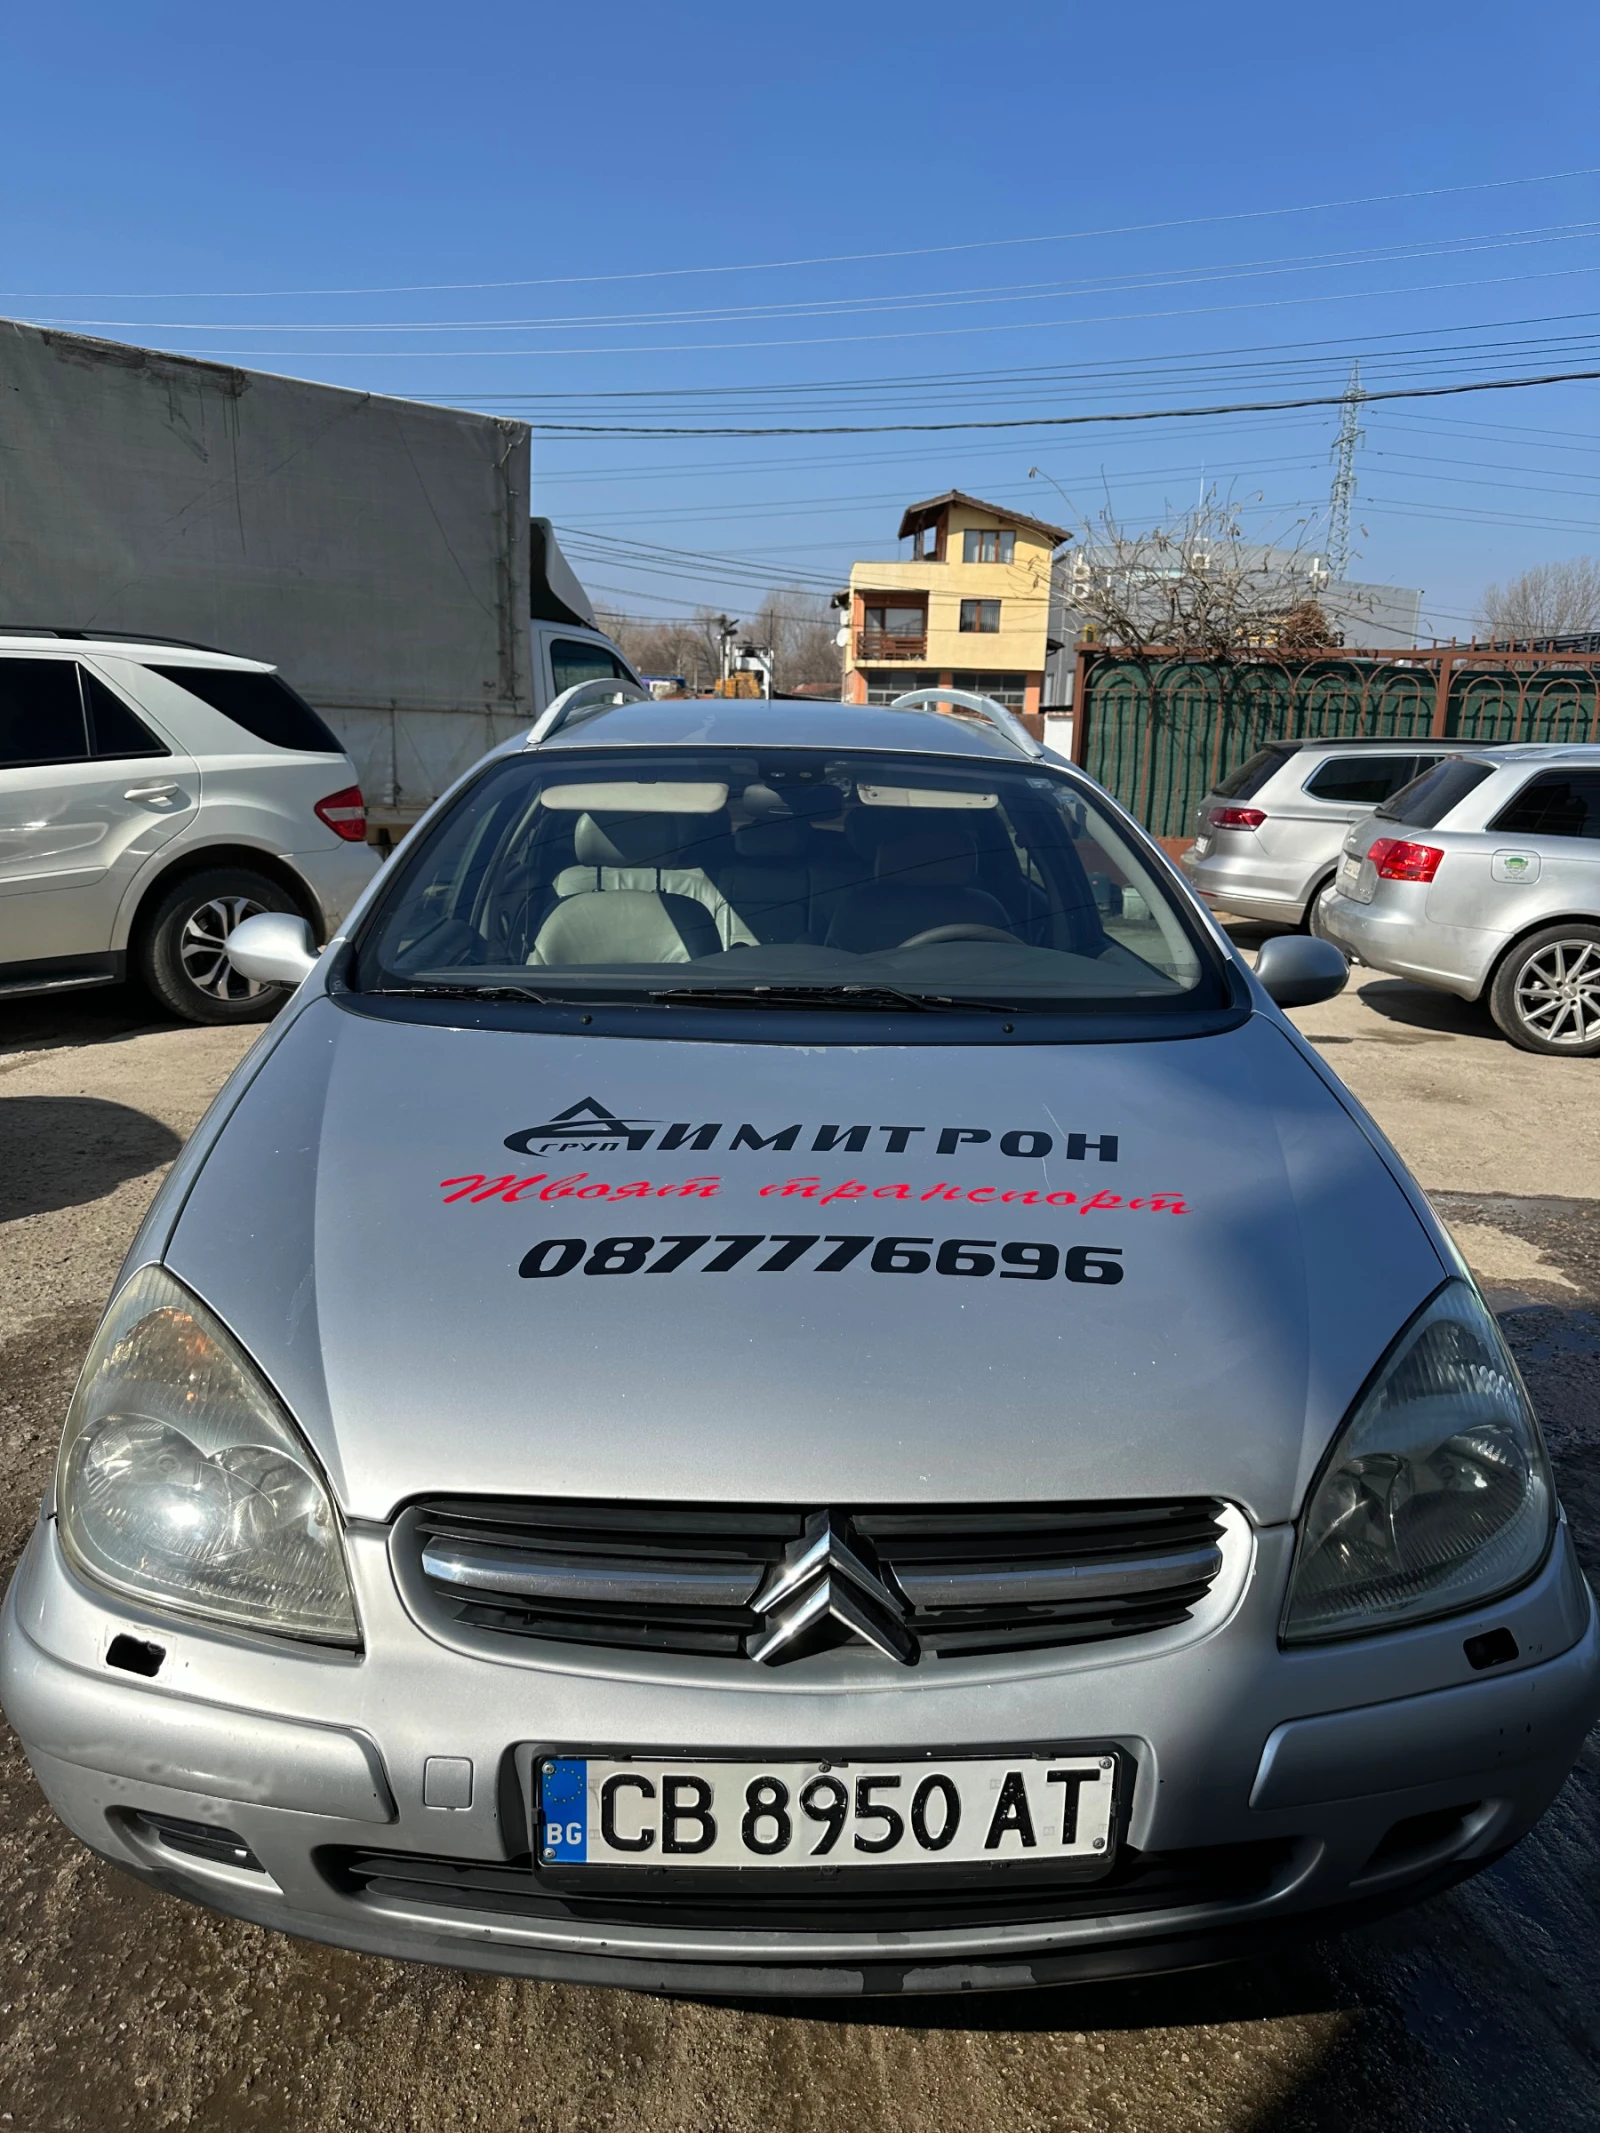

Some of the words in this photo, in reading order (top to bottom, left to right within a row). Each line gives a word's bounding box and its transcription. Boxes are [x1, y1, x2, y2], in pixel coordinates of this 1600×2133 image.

[538, 1142, 620, 1153] ГРУП
[438, 1172, 722, 1205] Твоят
[757, 1175, 1196, 1217] транспорт
[518, 1234, 1125, 1287] 0877776696
[546, 1822, 583, 1846] BG
[600, 1773, 716, 1855] CB
[740, 1773, 961, 1857] 8950
[983, 1767, 1101, 1851] AT
